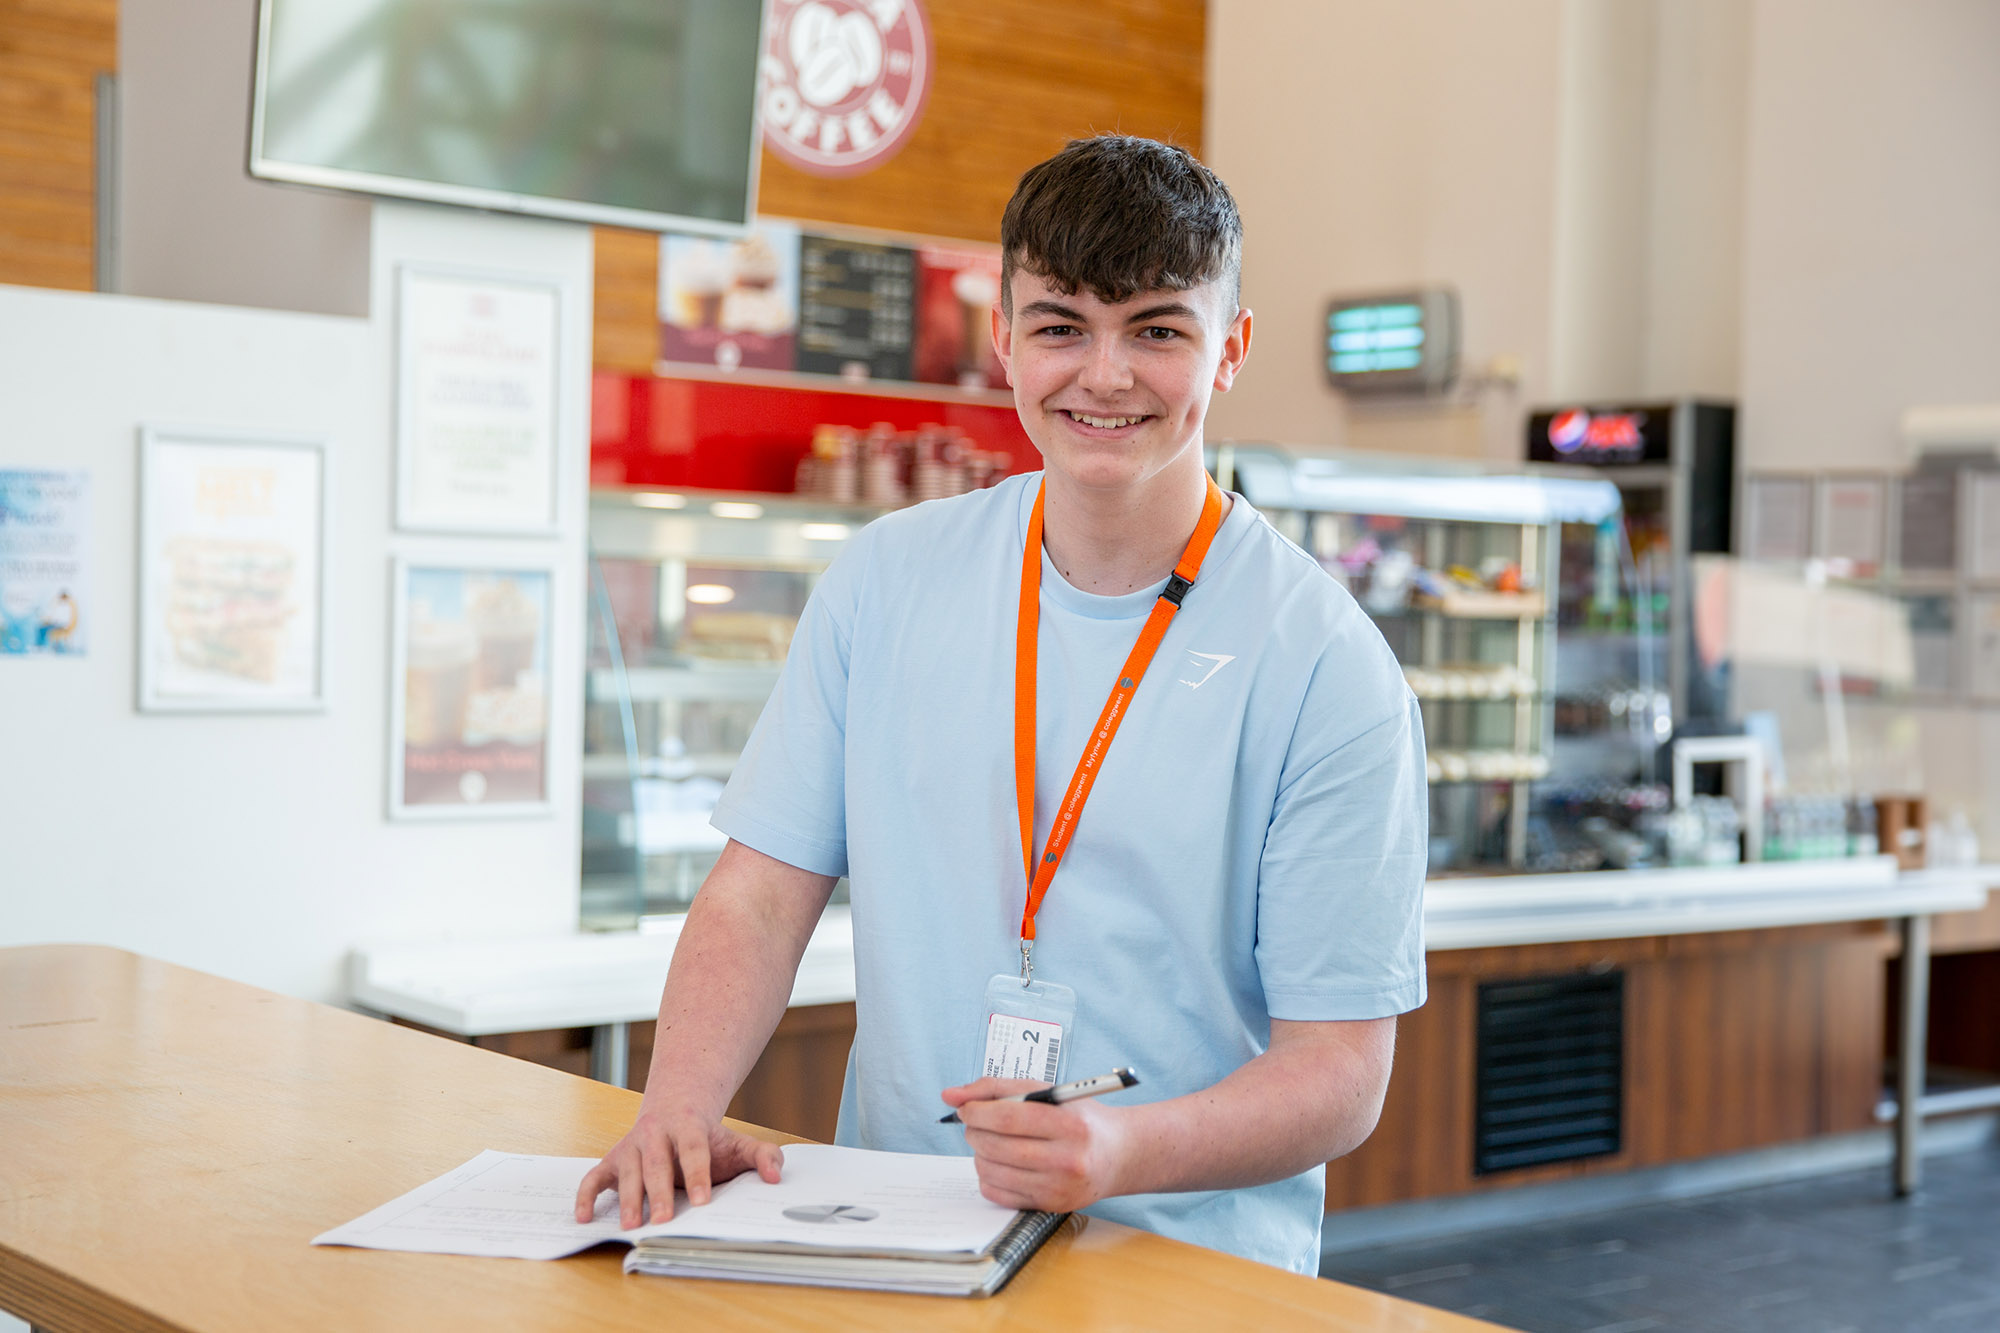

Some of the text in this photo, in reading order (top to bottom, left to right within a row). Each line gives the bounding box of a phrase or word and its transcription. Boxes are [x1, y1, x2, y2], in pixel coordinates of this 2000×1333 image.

[1085, 693, 1125, 768] Myfyriwr @ coleggwent
[1053, 773, 1088, 848] Student @ coleggwent
[1022, 1030, 1040, 1044] 2
